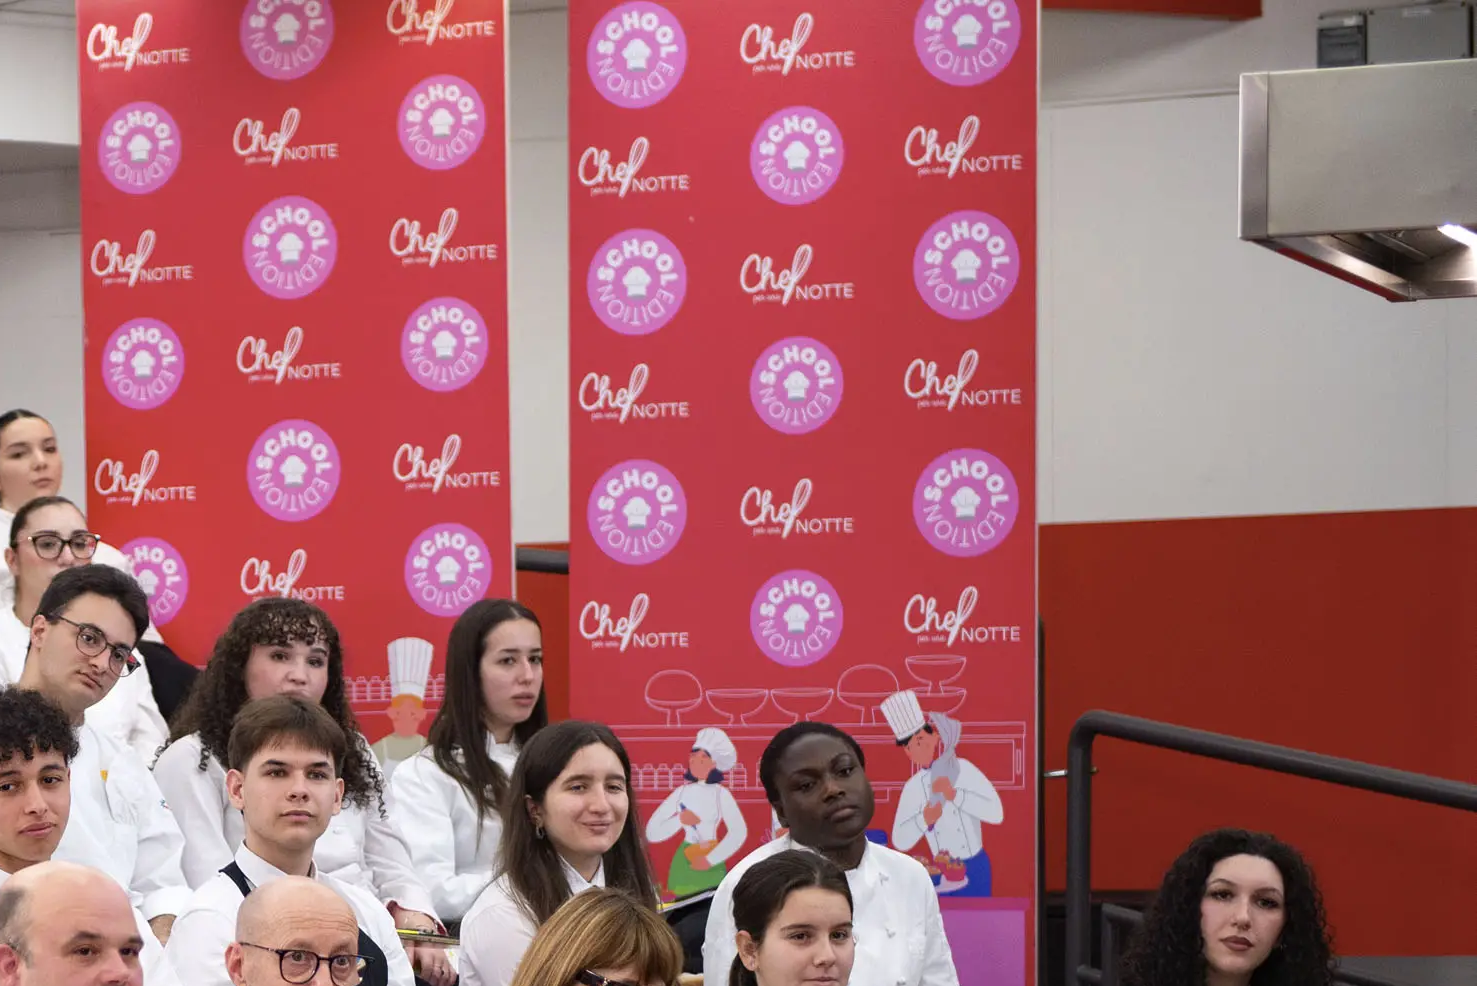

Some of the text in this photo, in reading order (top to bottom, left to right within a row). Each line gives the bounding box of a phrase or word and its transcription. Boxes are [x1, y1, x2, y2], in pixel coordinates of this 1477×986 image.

[249, 0, 325, 30] SCOL
[438, 20, 496, 39] NOTTE
[597, 10, 678, 56] SCHOOL
[925, 0, 1011, 34] SCOL
[87, 13, 191, 71] Chef NOTTE
[248, 32, 323, 70] EDITION
[740, 12, 856, 76] Chef NOTTE
[924, 33, 1008, 76] EDITION
[597, 57, 675, 99] EDITION
[406, 84, 478, 124] SCHOOL
[106, 110, 173, 149] SCHOOL
[233, 108, 339, 167] Chef NOTTE
[406, 125, 475, 162] EDITION
[759, 114, 835, 156] SCHOOL
[904, 115, 1022, 179] Chef NOTTE
[106, 150, 170, 186] EDITION
[578, 136, 690, 197] Chef NOTTE
[759, 157, 832, 196] EDITION
[253, 205, 328, 249] SCHOOL
[389, 208, 498, 268] Chef NOTTE
[924, 220, 1009, 267] SCHOOL
[91, 230, 193, 287] Chef NOTTE
[253, 250, 325, 290] EDITION
[596, 238, 678, 283] SCHOOL
[740, 244, 854, 306] Chef NOTTE
[596, 284, 674, 325] EDITION
[924, 268, 1005, 310] EDITION
[110, 326, 176, 364] SCHOOL
[409, 306, 480, 346] SCHOOL
[236, 326, 341, 385] Chef NOTTE
[409, 347, 477, 384] EDITION
[759, 344, 834, 386] SCHOOL
[110, 365, 173, 401] EDITION
[578, 363, 690, 424] Chef NOTTE
[904, 349, 1022, 411] Chef NOTTE
[759, 387, 831, 425] EDITION
[256, 429, 331, 472] SCHOOL
[393, 434, 500, 493] Chef NOTTE
[94, 449, 196, 506] Chef NOTTE
[256, 473, 328, 513] EDITION
[596, 469, 678, 514] SCHOOL
[923, 458, 1008, 504] SCHOOL
[740, 478, 854, 539] Chef NOTTE
[923, 505, 1004, 546] EDITION
[413, 531, 484, 571] SCHOOL
[596, 515, 674, 556] EDITION
[240, 549, 345, 602] Chef NOTTE
[413, 572, 481, 609] EDITION
[759, 578, 834, 619] SCHOOL
[903, 586, 1021, 647] Chef NOTTE
[578, 593, 689, 652] Chef NOTTE
[759, 620, 831, 657] EDITION
